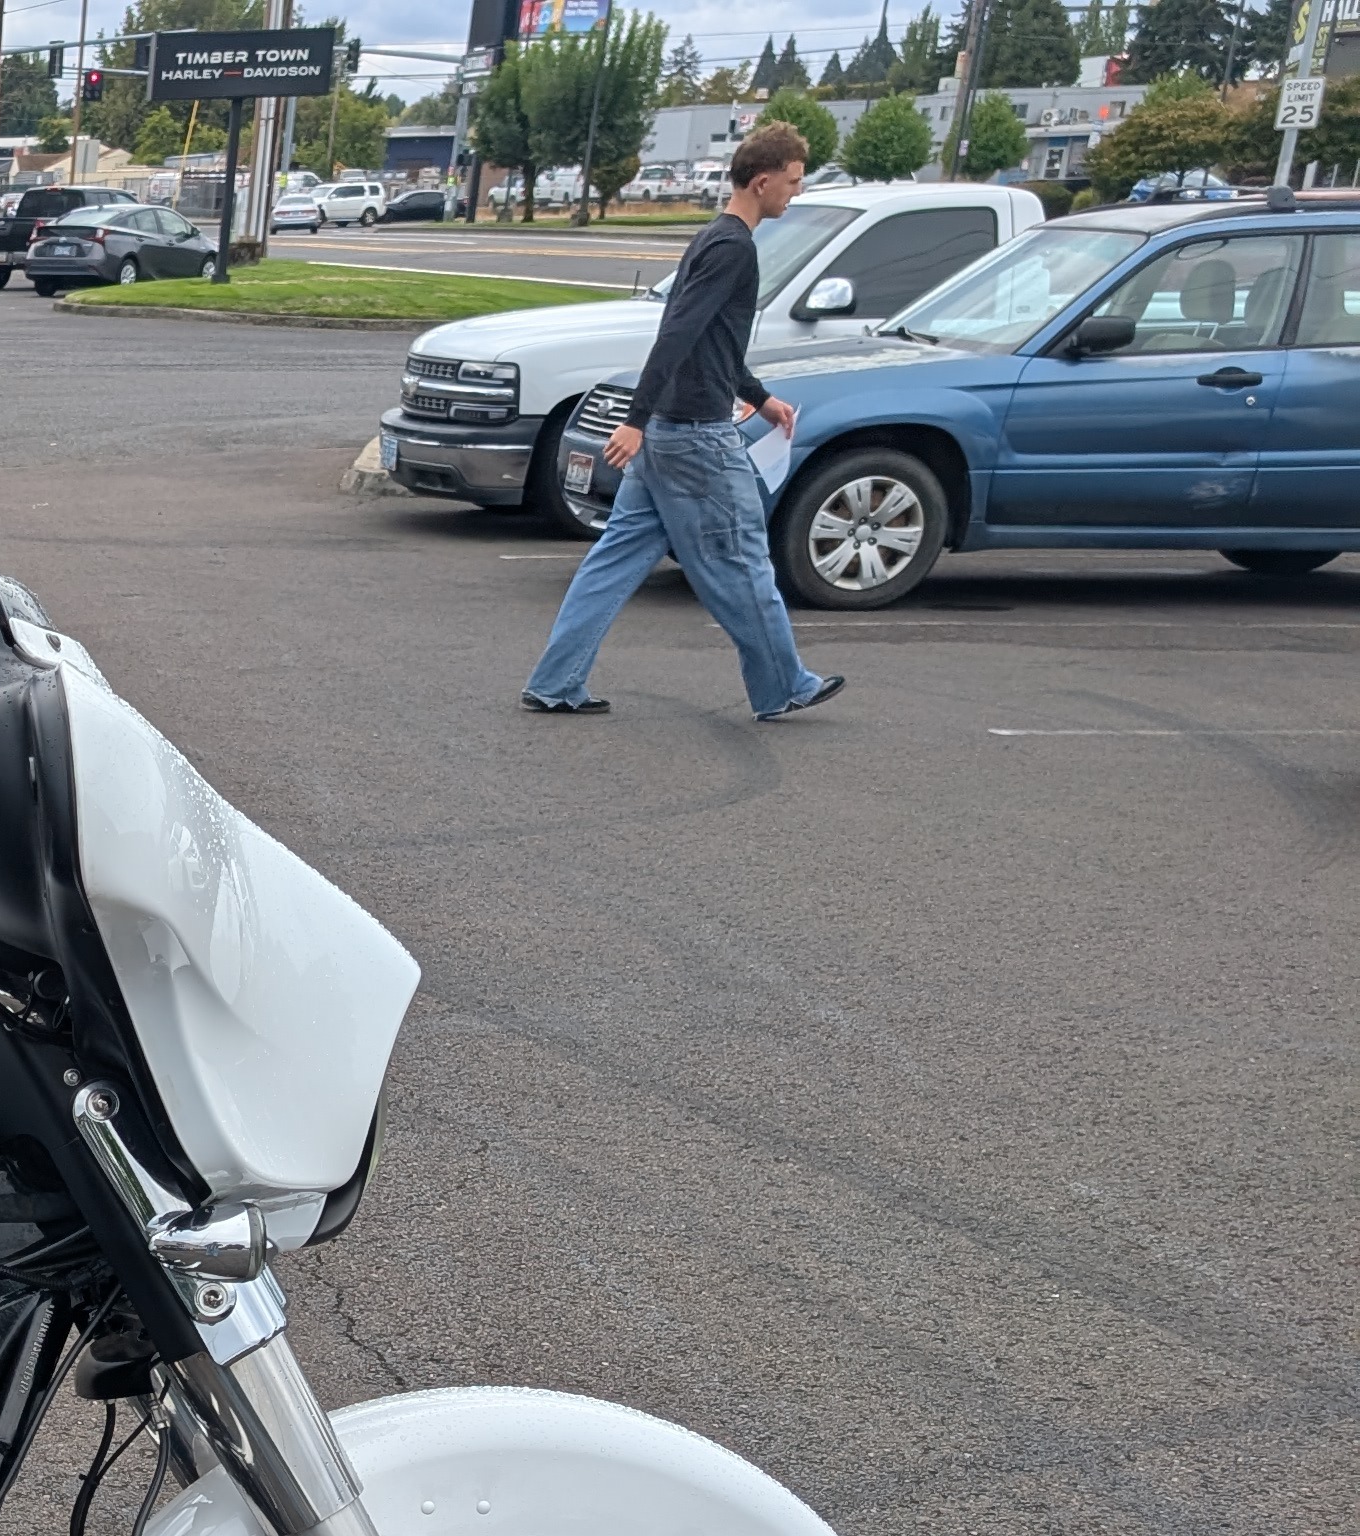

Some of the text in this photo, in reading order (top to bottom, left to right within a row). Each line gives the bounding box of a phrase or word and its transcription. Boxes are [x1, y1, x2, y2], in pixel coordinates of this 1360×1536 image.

[175, 49, 310, 65] TIMBER TOWN
[1285, 82, 1321, 91] SPEED
[1287, 94, 1314, 103] LIMIT
[1280, 105, 1314, 124] 25
